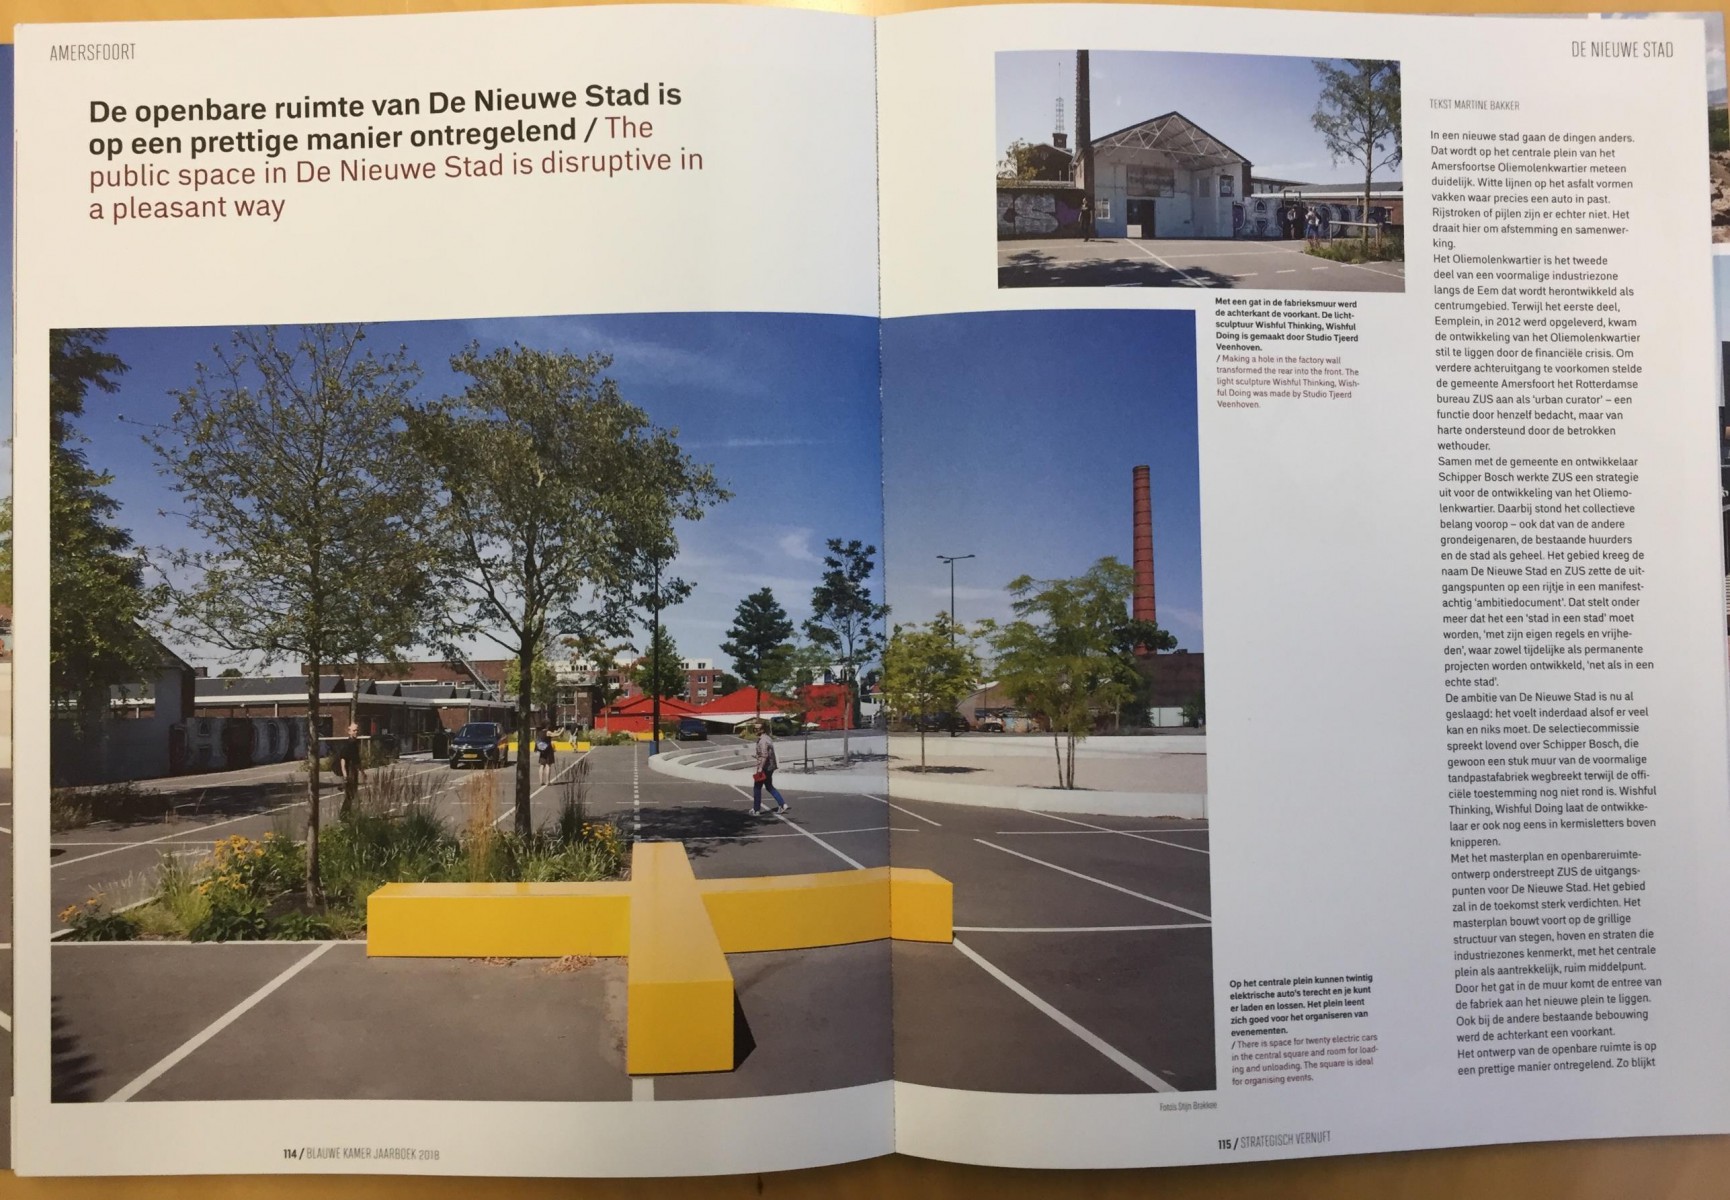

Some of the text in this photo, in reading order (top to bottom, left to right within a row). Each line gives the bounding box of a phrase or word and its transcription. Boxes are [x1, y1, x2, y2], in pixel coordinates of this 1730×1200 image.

[50, 43, 136, 61] AMERSFOORT
[1571, 41, 1674, 58] DE NIEUWE STAD
[90, 82, 682, 127] De openbare ruimte van De Nieuwe Stad is
[1429, 98, 1520, 111] TEKST MARTINE BAKKER
[89, 115, 653, 161] op een prettige manier ontregelend / The
[1430, 130, 1635, 145] In een nieuwe stad gaan de dingen anders.
[90, 147, 703, 192] public space in De Nieuwe Stad is disruptive in
[1431, 161, 1627, 173] Amersfoortse Oliemolenkwartier meteen
[89, 196, 285, 225] a pleasant way
[1215, 297, 1231, 305] Met
[1248, 299, 1262, 308] gat
[1263, 298, 1271, 306] in
[1272, 298, 1283, 306] de
[1284, 299, 1336, 308] fabrieksmuur
[1337, 300, 1357, 308] werd
[1215, 309, 1354, 319] de achterkant de voorkant. De licht-
[1215, 320, 1356, 332] sculptuur Wishful Thinking, Wishful
[1435, 316, 1637, 329] Eemplein, in 2012 werd opgeleverd, kwam
[1216, 331, 1359, 343] Doing is gemaakt door Studio Tjeerd
[1216, 366, 1263, 374] transformed
[1264, 367, 1277, 375] the
[1310, 367, 1323, 376] the
[1324, 367, 1344, 376] front.
[1345, 368, 1359, 376] The
[1438, 456, 1472, 466] Samen
[1474, 457, 1493, 466] met
[1495, 457, 1508, 466] de
[1510, 457, 1559, 469] gemeente
[1575, 457, 1638, 466] ontwikkelaar
[1441, 565, 1645, 576] naam De Nieuwe Stad en ZUS zette de uit-
[1447, 738, 1639, 753] spreekt lovend over Schipper Bosch, die
[1454, 944, 1656, 961] industriezones kenmerkt, met het centrale
[1229, 973, 1373, 990] Op het centrale plein kunnen twintig
[1230, 990, 1275, 1000] elektrische
[1276, 989, 1301, 998] auto's
[1302, 988, 1331, 997] terecht
[1344, 986, 1352, 996] je
[1353, 986, 1371, 994] kunt
[1230, 1016, 1248, 1025] zich
[1248, 1015, 1270, 1026] goed
[1290, 1013, 1304, 1021] het
[1305, 1011, 1353, 1022] organiseren
[1456, 1009, 1649, 1027] Ook bij de andere bestaande bebouwing
[1231, 1041, 1236, 1050] /
[1237, 1040, 1260, 1049] There
[1269, 1039, 1292, 1048] space
[1293, 1037, 1304, 1046] for
[1305, 1037, 1331, 1046] twenty
[1332, 1034, 1360, 1043] electric
[1361, 1034, 1378, 1042] cars
[1232, 1074, 1314, 1087] for organising events.
[1218, 1130, 1331, 1151] 115 / STRATEGISCH VERNUFT
[283, 1147, 440, 1160] 114 / BLAUWE KAMER JAARBOEK 2018
